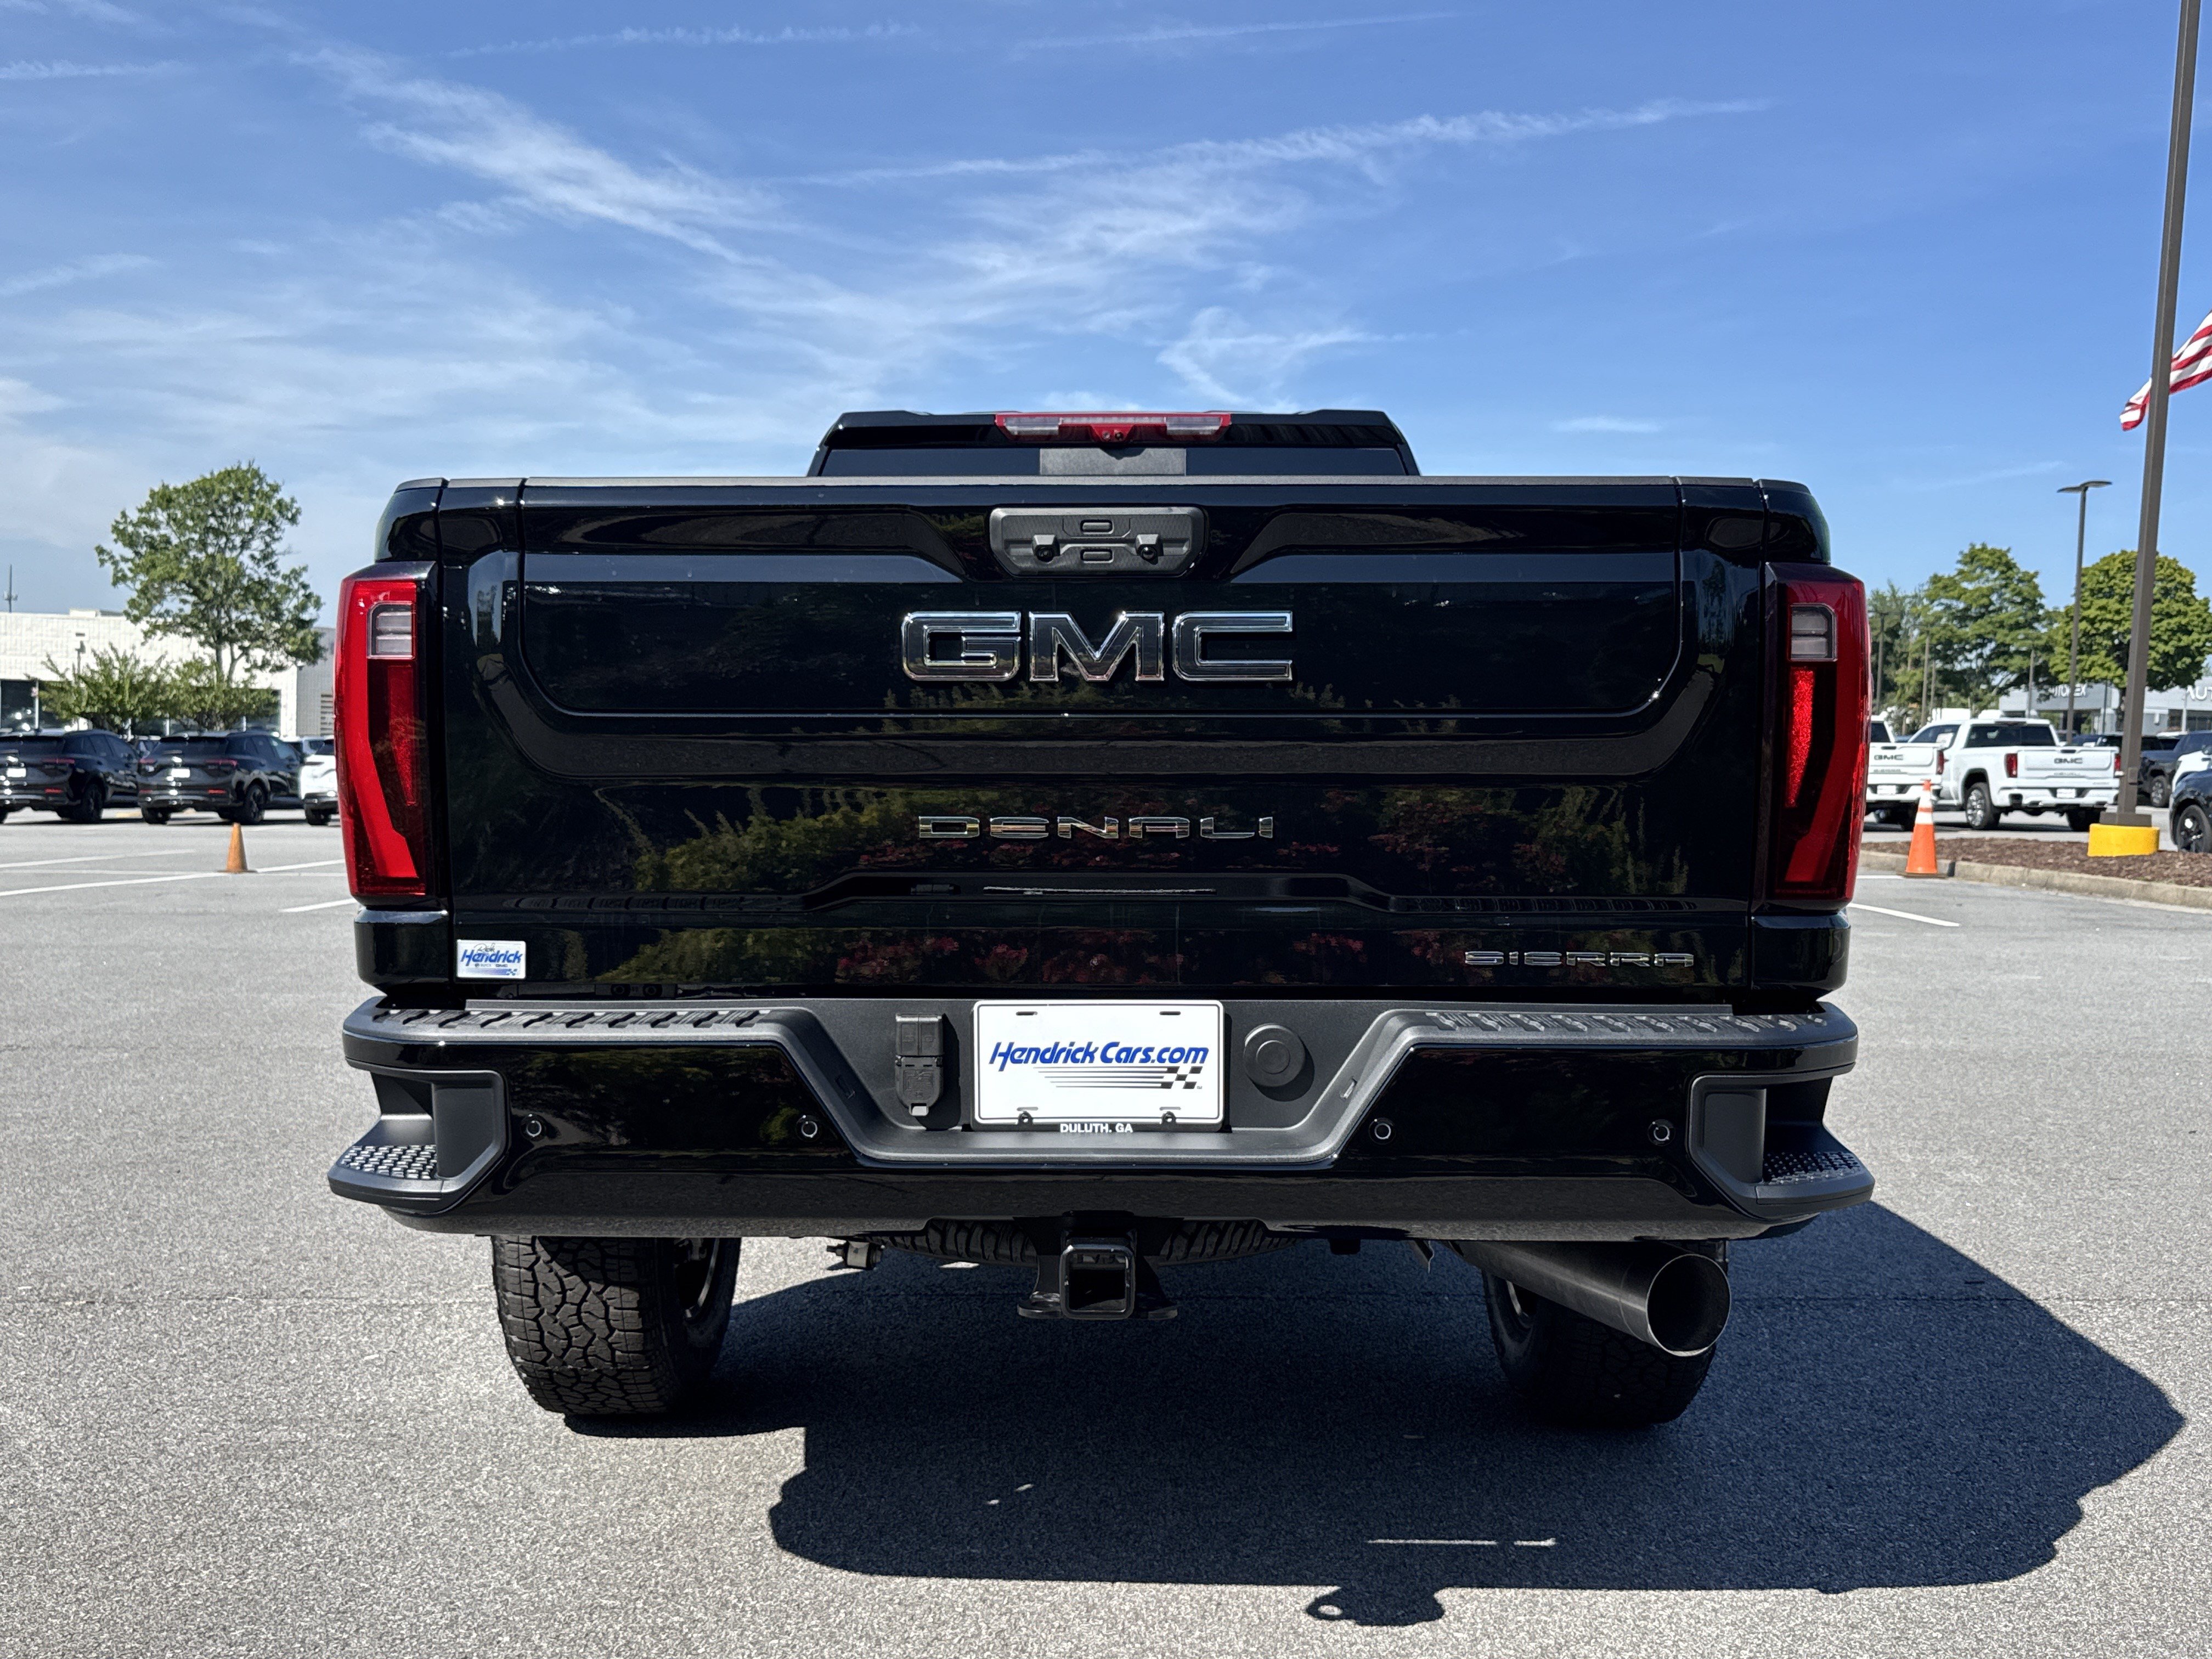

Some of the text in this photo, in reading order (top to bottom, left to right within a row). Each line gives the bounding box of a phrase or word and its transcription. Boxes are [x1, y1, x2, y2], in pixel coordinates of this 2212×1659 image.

[901, 611, 1293, 682] GMC
[919, 816, 1273, 839] DENALI
[460, 950, 523, 967] Hendrick
[1465, 951, 1694, 967] SIERRA
[1115, 1122, 1133, 1133] GA
